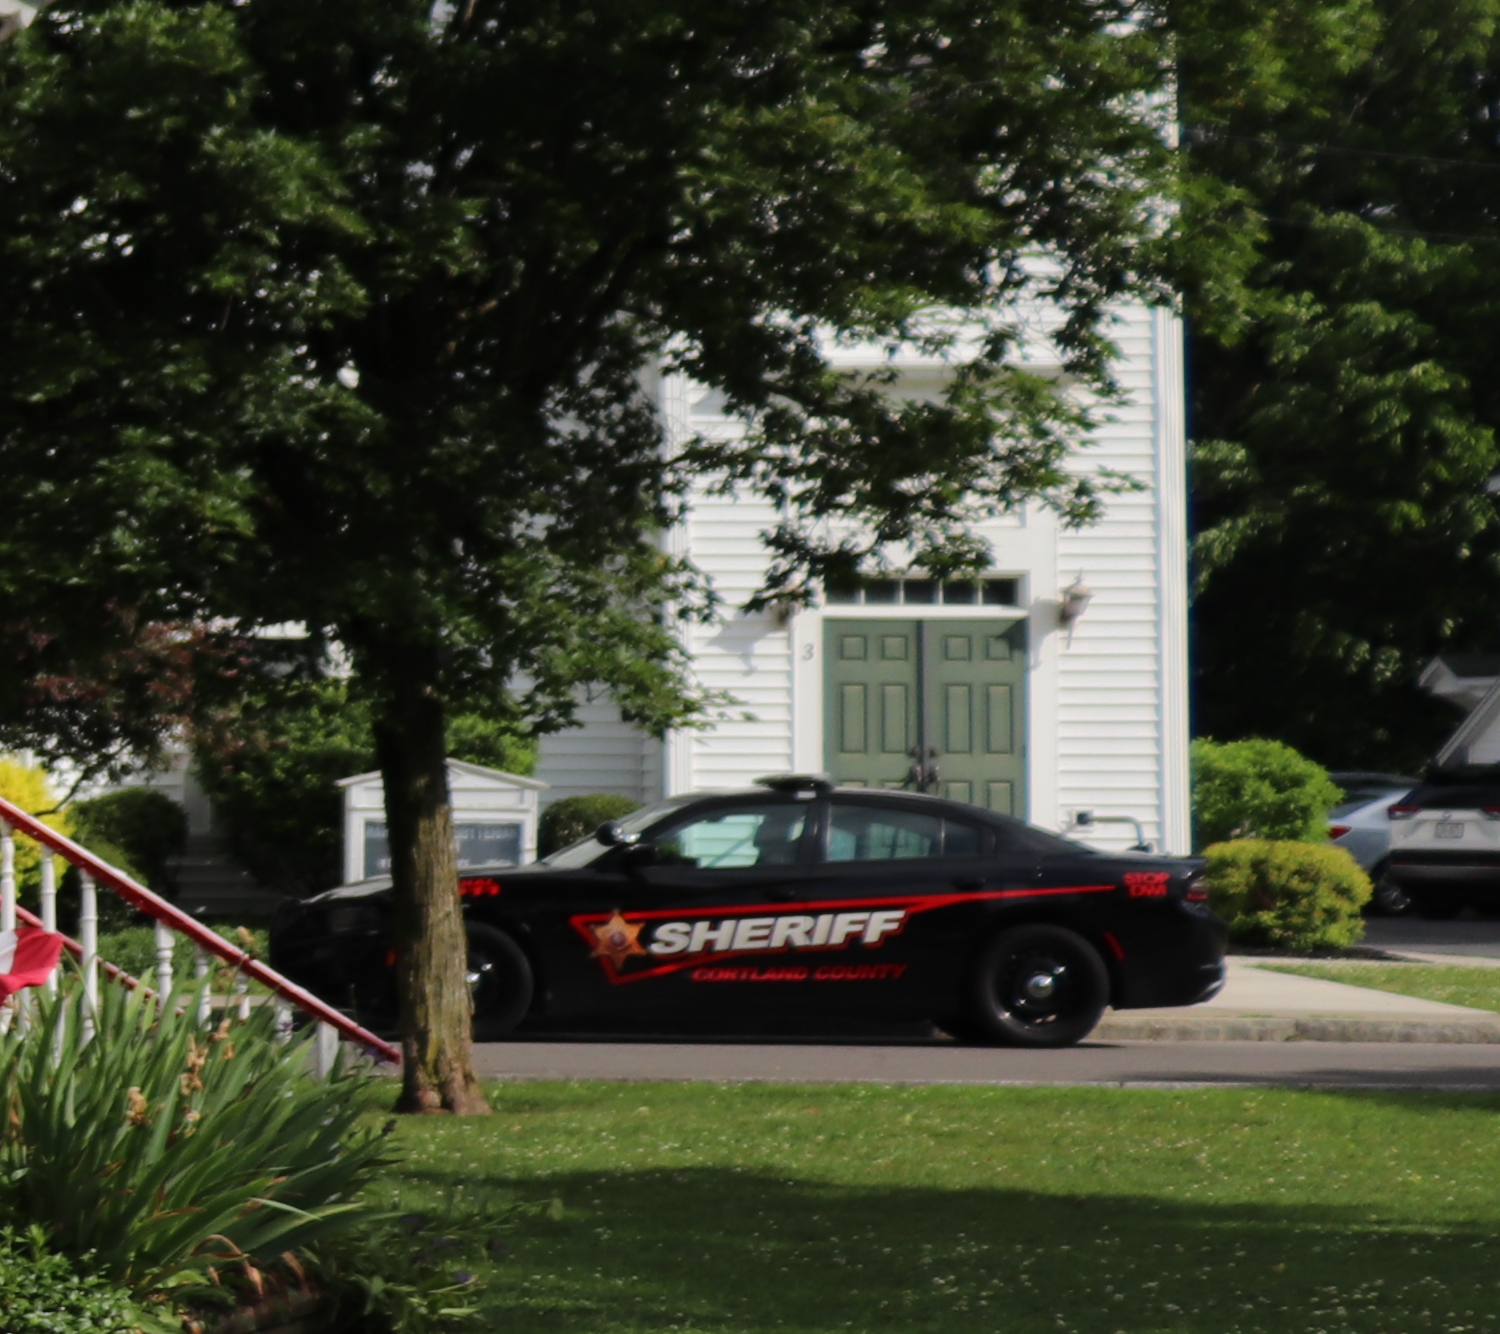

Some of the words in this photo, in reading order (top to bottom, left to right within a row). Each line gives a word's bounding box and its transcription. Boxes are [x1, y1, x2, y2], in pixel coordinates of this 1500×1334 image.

[1124, 872, 1171, 885] STOP
[650, 910, 906, 955] SHERIFF
[692, 966, 808, 981] CORTLAND
[815, 964, 908, 980] COUNTY
